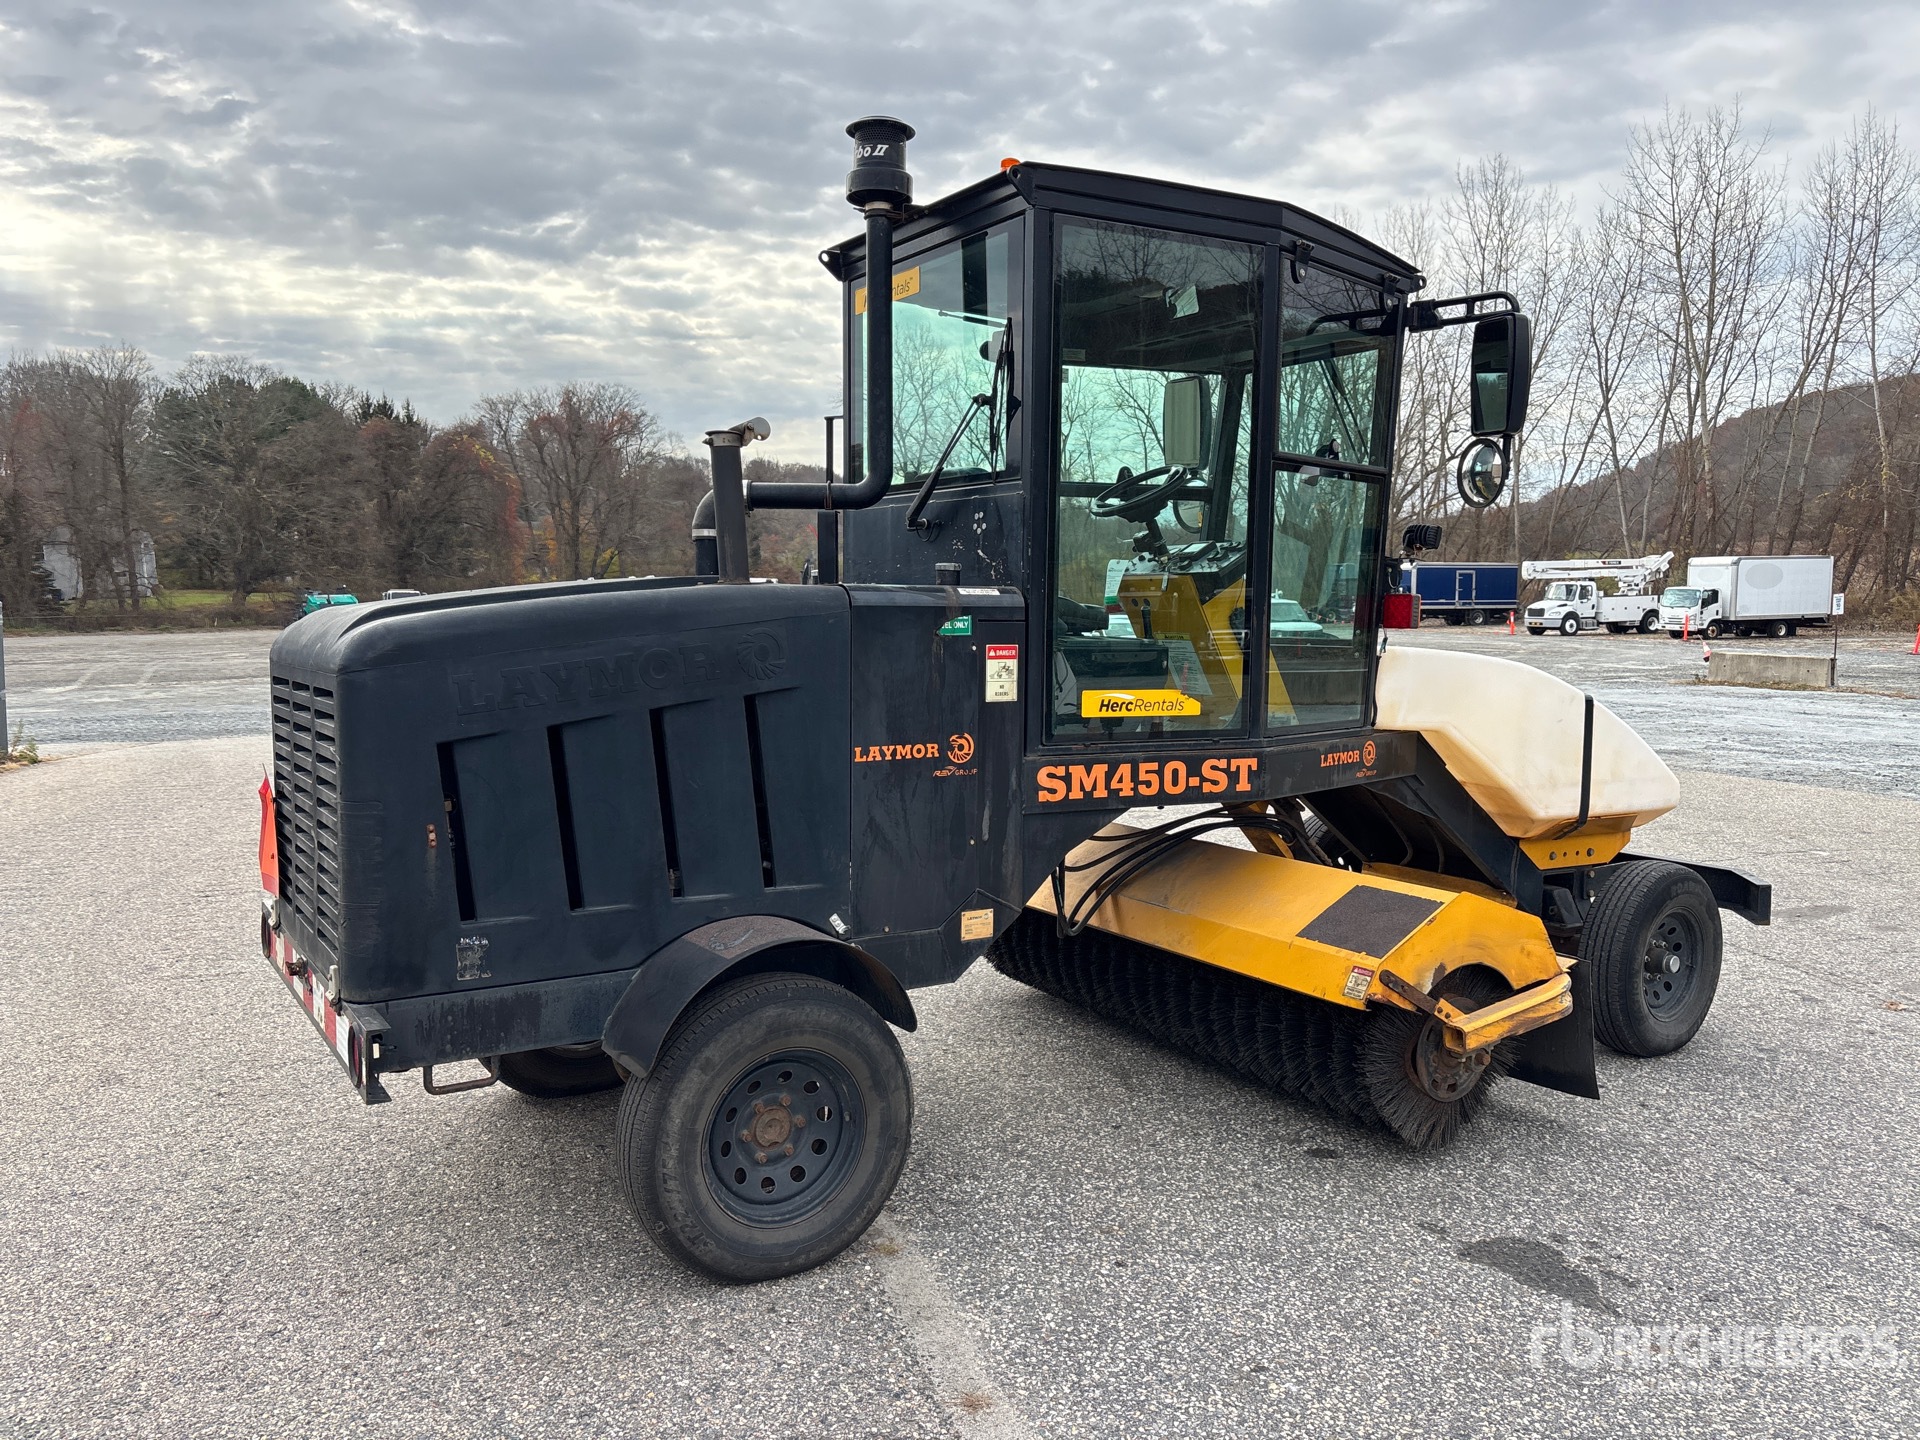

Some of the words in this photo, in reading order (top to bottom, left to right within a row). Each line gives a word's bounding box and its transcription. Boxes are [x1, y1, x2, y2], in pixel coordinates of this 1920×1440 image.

[953, 621, 969, 629] ONLY
[452, 643, 721, 716] LAYMOR
[1098, 698, 1185, 713] HercRentals
[854, 743, 940, 762] LAYMOR
[1320, 750, 1360, 768] LAYMOR
[1036, 757, 1258, 803] SM450-ST
